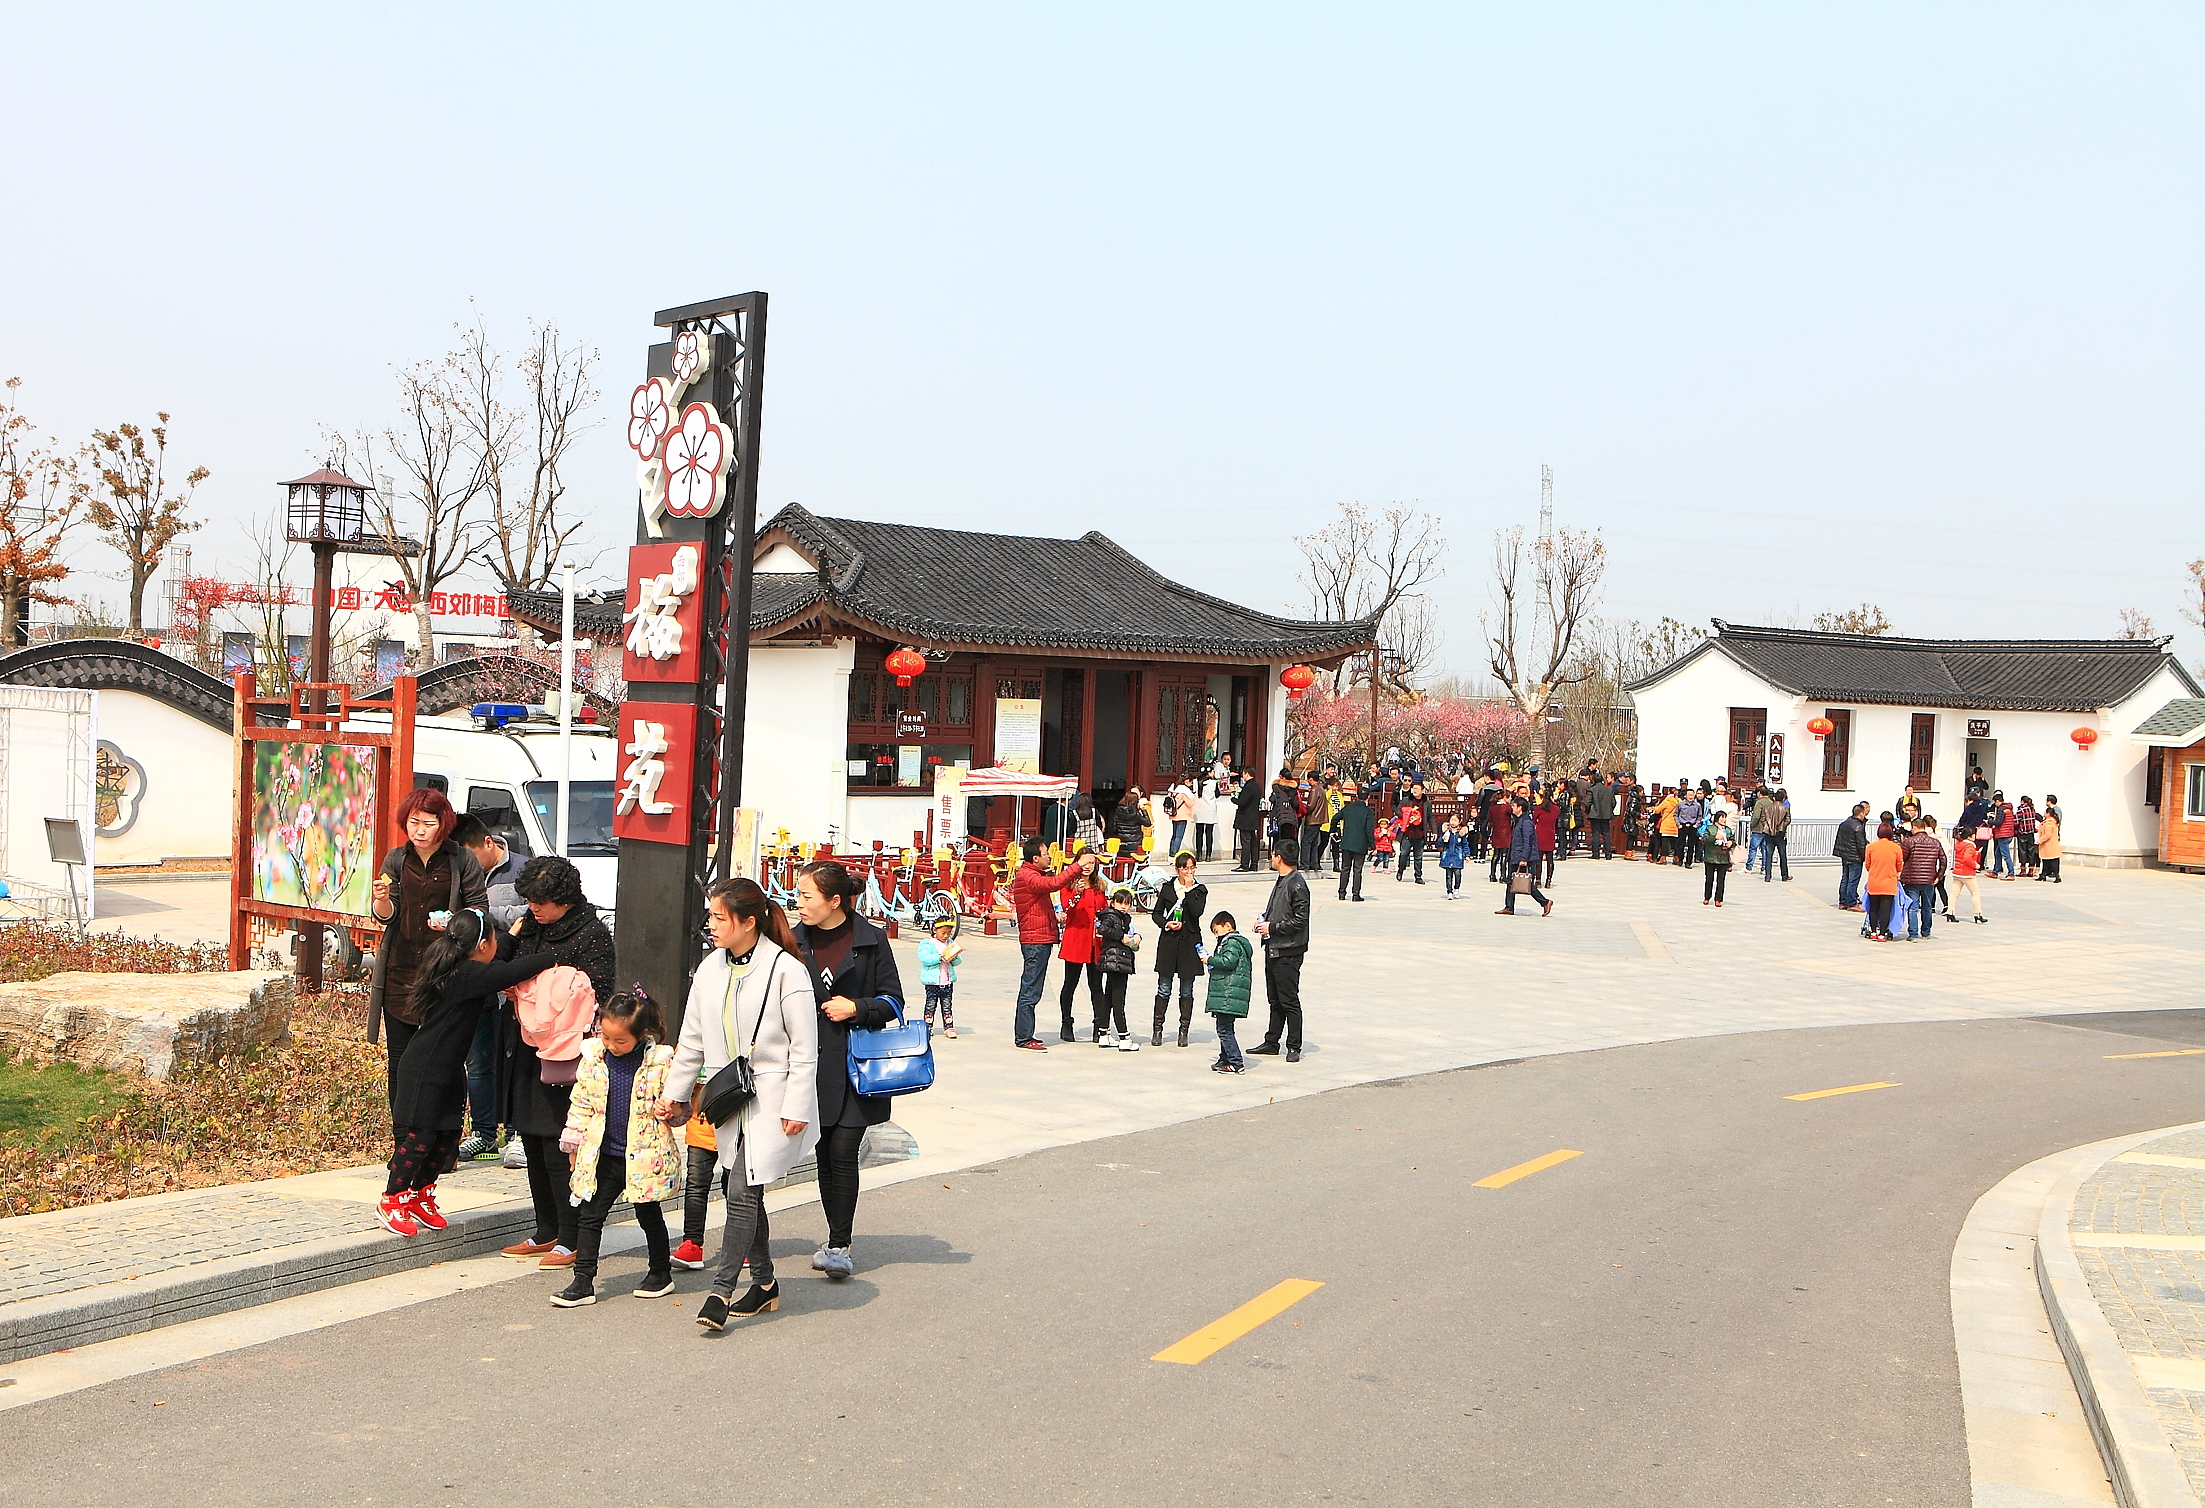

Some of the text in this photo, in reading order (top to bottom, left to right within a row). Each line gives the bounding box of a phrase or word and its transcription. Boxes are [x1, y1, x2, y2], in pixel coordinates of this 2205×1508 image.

[1769, 738, 1782, 779] 入口处
[939, 794, 953, 849] 售票
